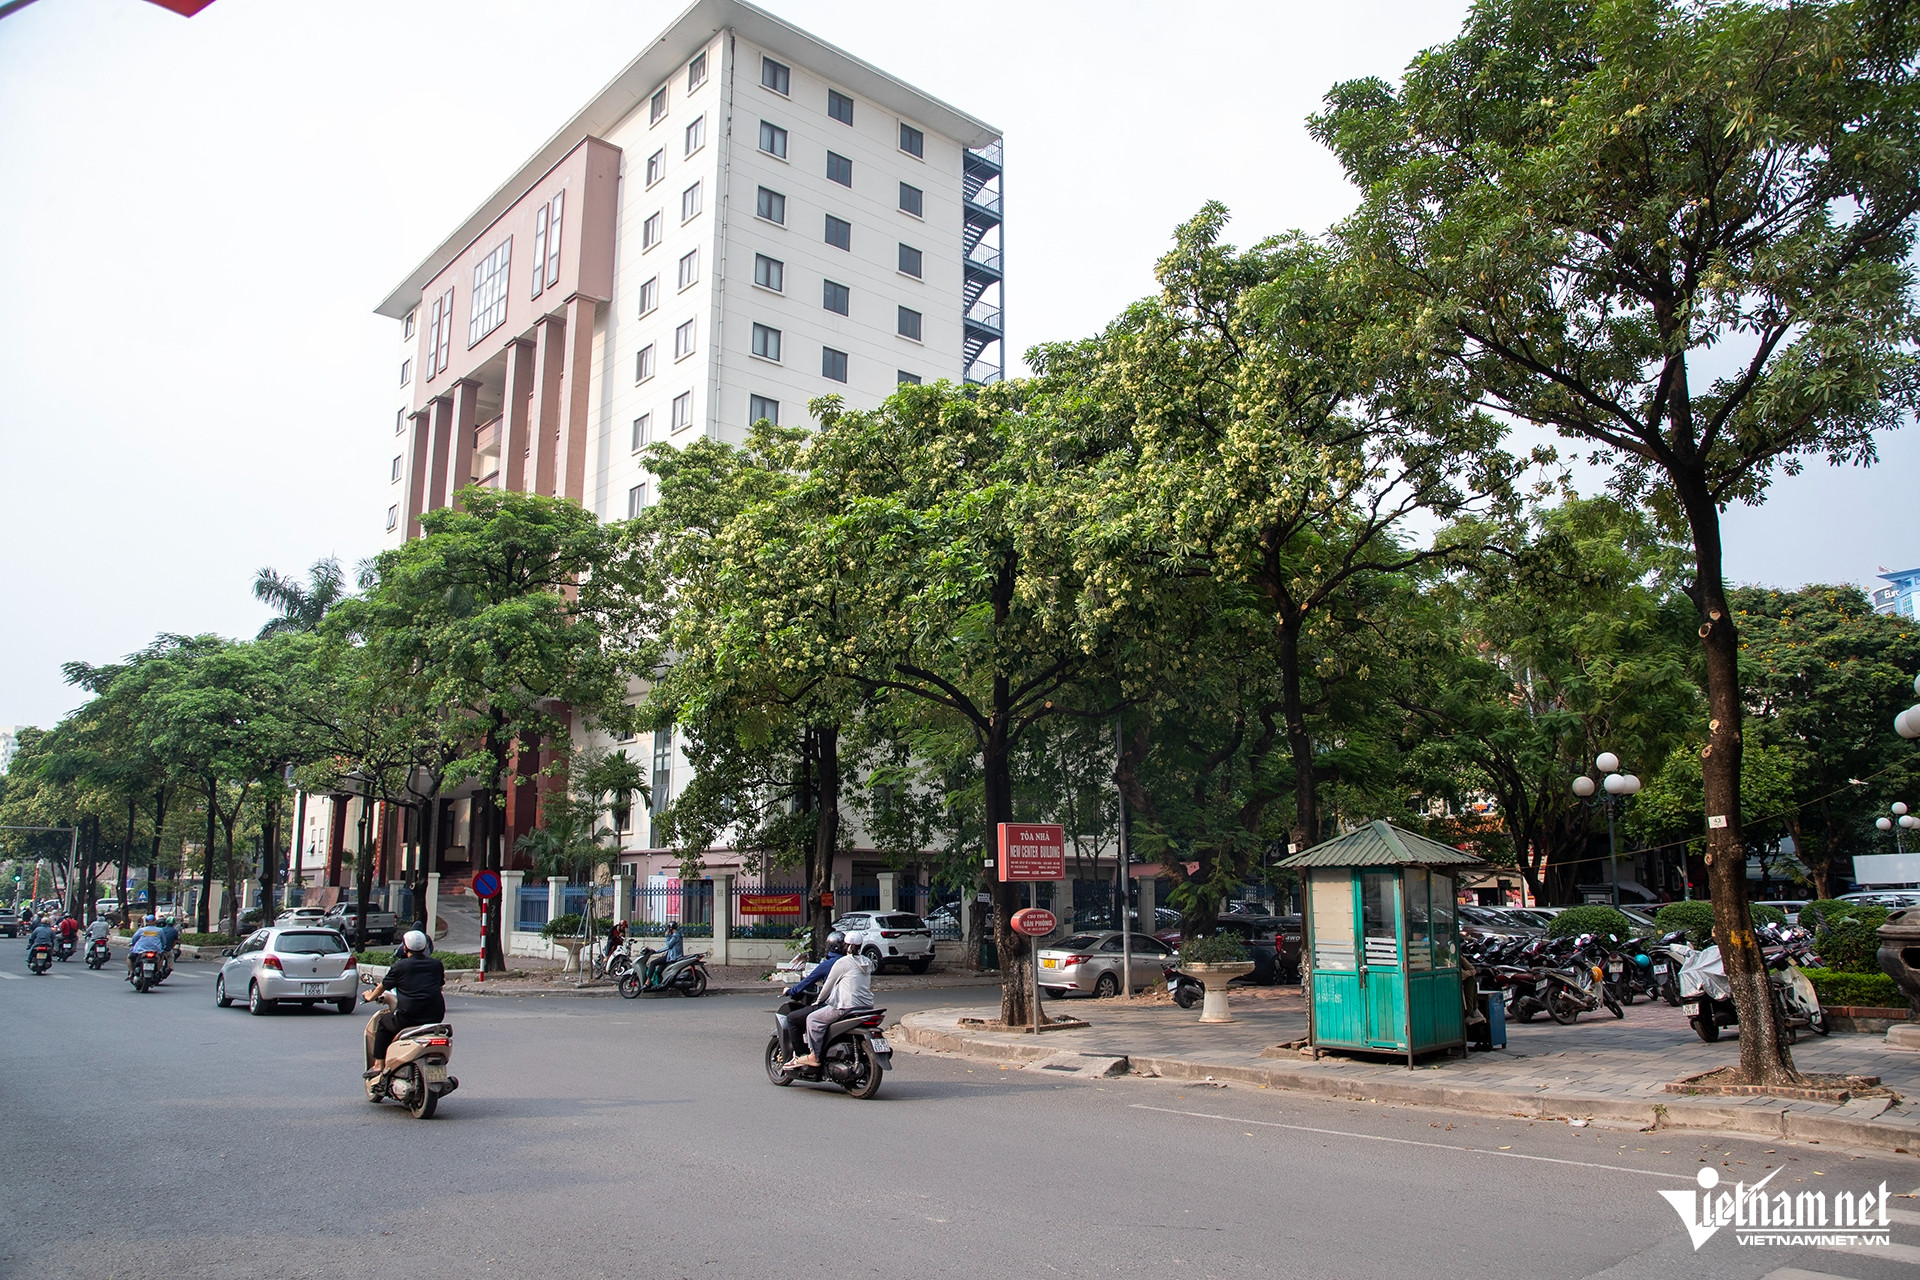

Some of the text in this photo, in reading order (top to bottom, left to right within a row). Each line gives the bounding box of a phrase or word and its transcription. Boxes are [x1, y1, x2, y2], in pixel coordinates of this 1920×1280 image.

[1020, 830, 1050, 841] TÒA NHÀ
[1010, 845, 1060, 858] NEW CENTER BUILDING
[1023, 919, 1053, 927] VĂN PHÒNG
